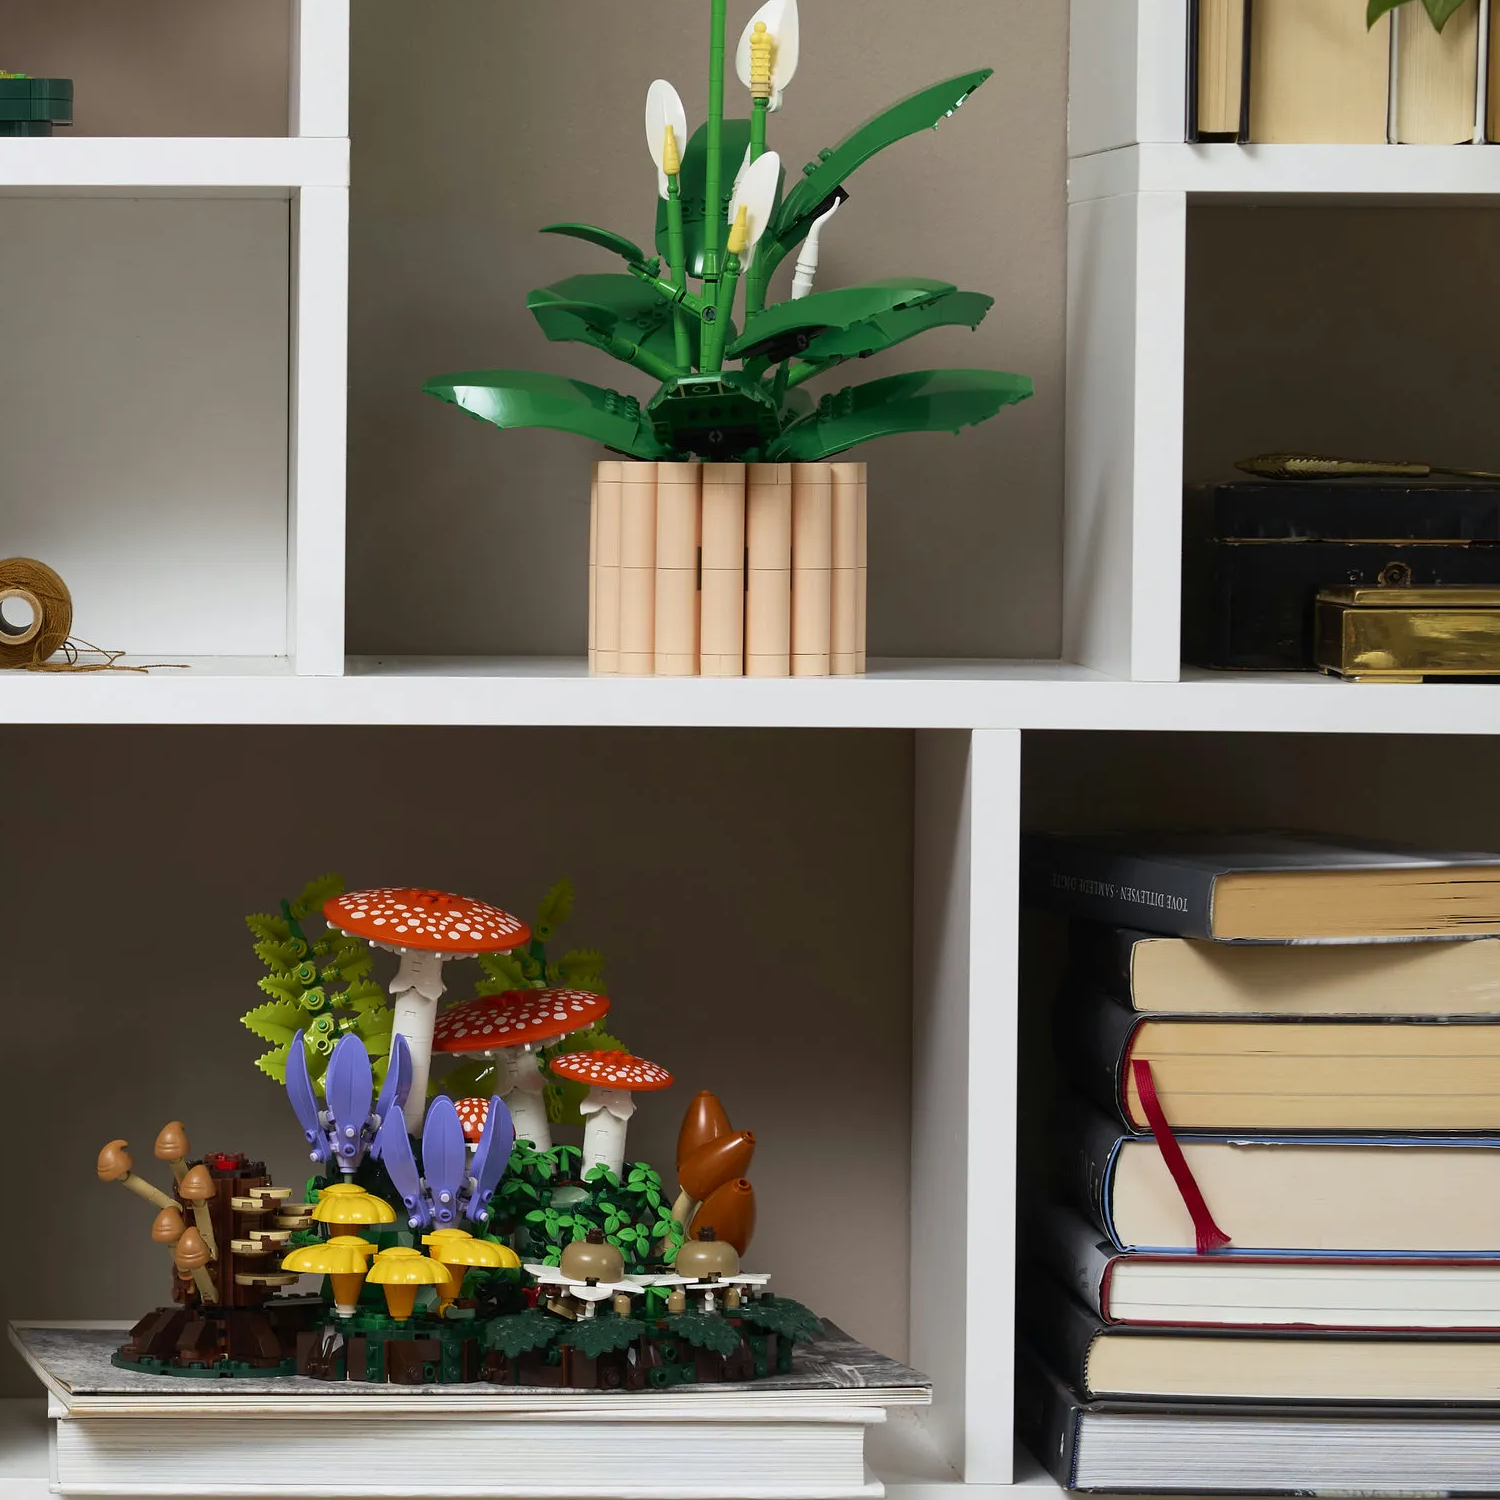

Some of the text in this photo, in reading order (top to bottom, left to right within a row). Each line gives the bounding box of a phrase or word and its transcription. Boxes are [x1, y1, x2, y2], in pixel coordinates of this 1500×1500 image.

[1078, 879, 1115, 898] SAMLEDE
[1120, 886, 1165, 908] DITLEVSEN
[1166, 895, 1189, 912] TOVE
